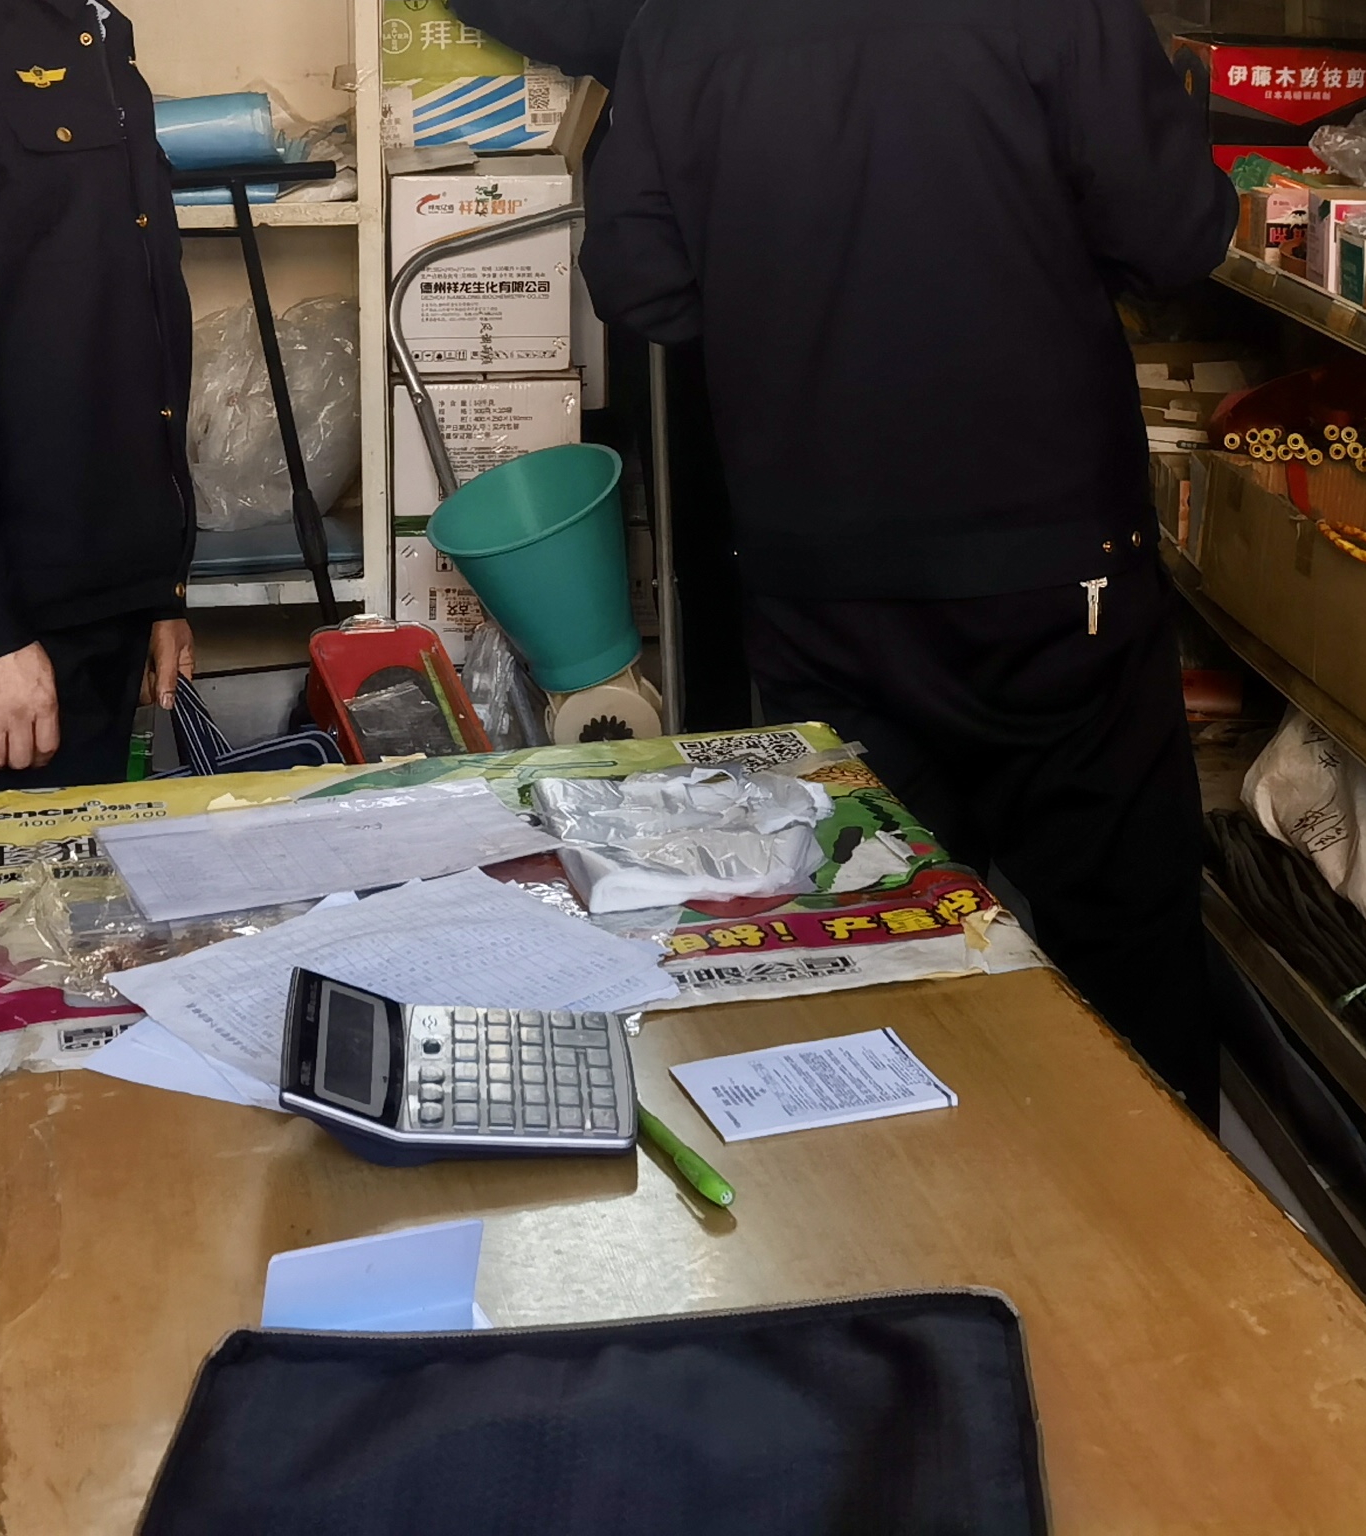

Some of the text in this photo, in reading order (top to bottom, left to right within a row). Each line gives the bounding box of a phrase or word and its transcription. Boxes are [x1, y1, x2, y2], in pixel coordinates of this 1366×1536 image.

[419, 20, 485, 51] 拜耳
[420, 281, 551, 295] 德州祥龙生化有限公司
